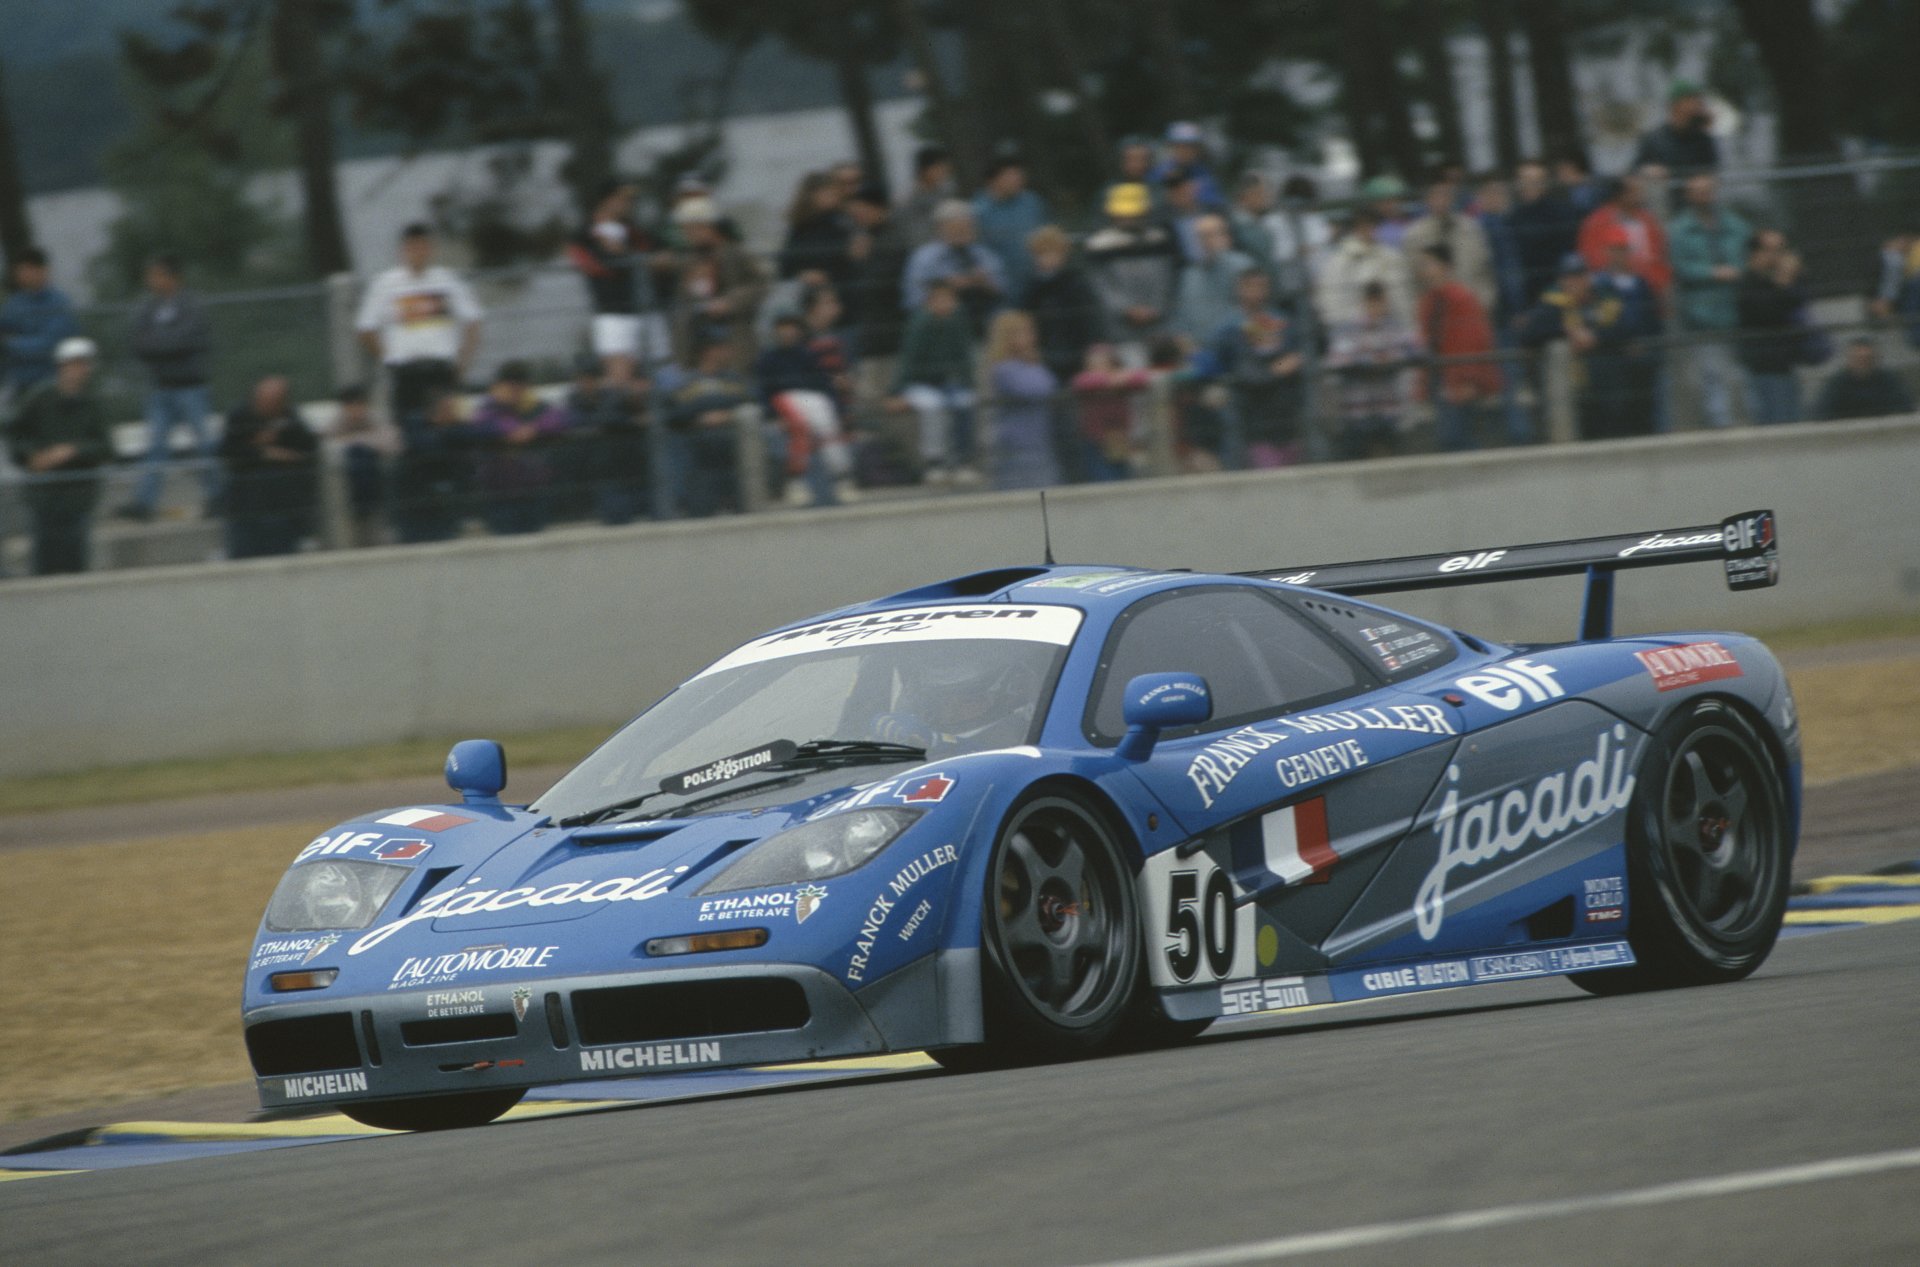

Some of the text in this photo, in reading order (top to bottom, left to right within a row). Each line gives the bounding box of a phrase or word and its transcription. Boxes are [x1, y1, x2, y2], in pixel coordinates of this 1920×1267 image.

[1723, 518, 1757, 552] elf
[1437, 550, 1507, 573] elf
[758, 609, 1038, 647] McLaren
[1455, 659, 1566, 711] elf
[1187, 704, 1457, 809] FRANCK MULLER
[1276, 739, 1368, 788] GENEVE
[293, 831, 384, 864] elf
[1413, 723, 1636, 941] jacadi
[349, 866, 689, 956] jacadi
[699, 907, 791, 921] DE BETTERAVE
[700, 892, 794, 912] ETHANOL
[847, 844, 959, 981] FRANCK MULLER
[898, 899, 932, 941] WATCH
[1164, 865, 1236, 983] 50
[256, 939, 316, 957] ETHANOL
[387, 972, 458, 990] MAGAZINE
[1362, 968, 1416, 991] CIBIE
[1415, 961, 1470, 985] BILSTEIN
[426, 990, 485, 1006] ETHANOL
[428, 1004, 485, 1018] DE BETTERAVE
[580, 1042, 720, 1071] MICHELIN
[284, 1071, 368, 1099] MICHELIN
